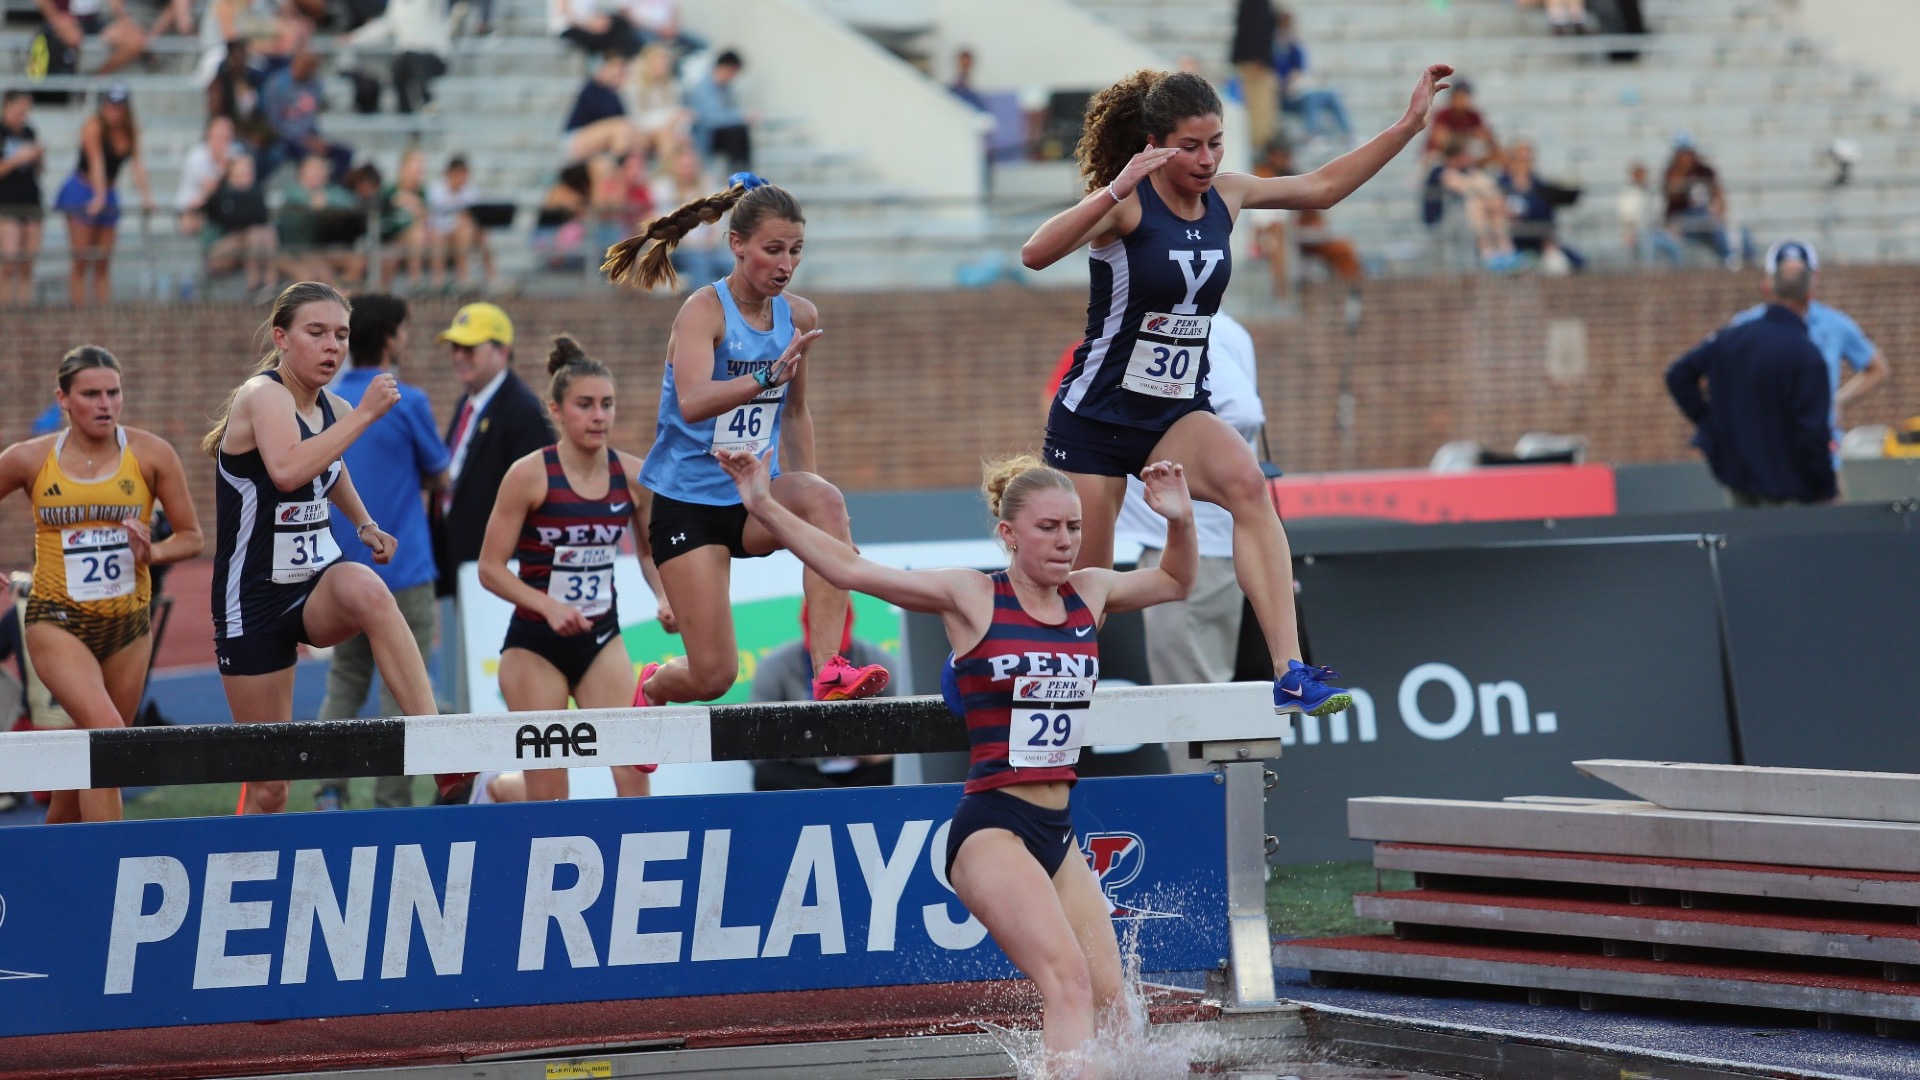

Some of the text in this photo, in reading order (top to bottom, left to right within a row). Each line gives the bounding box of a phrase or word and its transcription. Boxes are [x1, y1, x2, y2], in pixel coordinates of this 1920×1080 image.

[1169, 249, 1225, 315] Y
[1170, 327, 1203, 336] RELAYS
[1175, 318, 1199, 327] PENN
[1145, 346, 1190, 380] 30
[728, 406, 763, 438] 46
[290, 534, 325, 566] 31
[536, 524, 627, 549] PEN
[82, 554, 121, 583] 26
[565, 575, 600, 601] 33
[1045, 690, 1085, 699] RELAYS
[1047, 681, 1078, 689] PENN
[1399, 662, 1558, 741] On.
[1027, 713, 1071, 747] 29
[104, 818, 990, 995] PENN RELAYS
